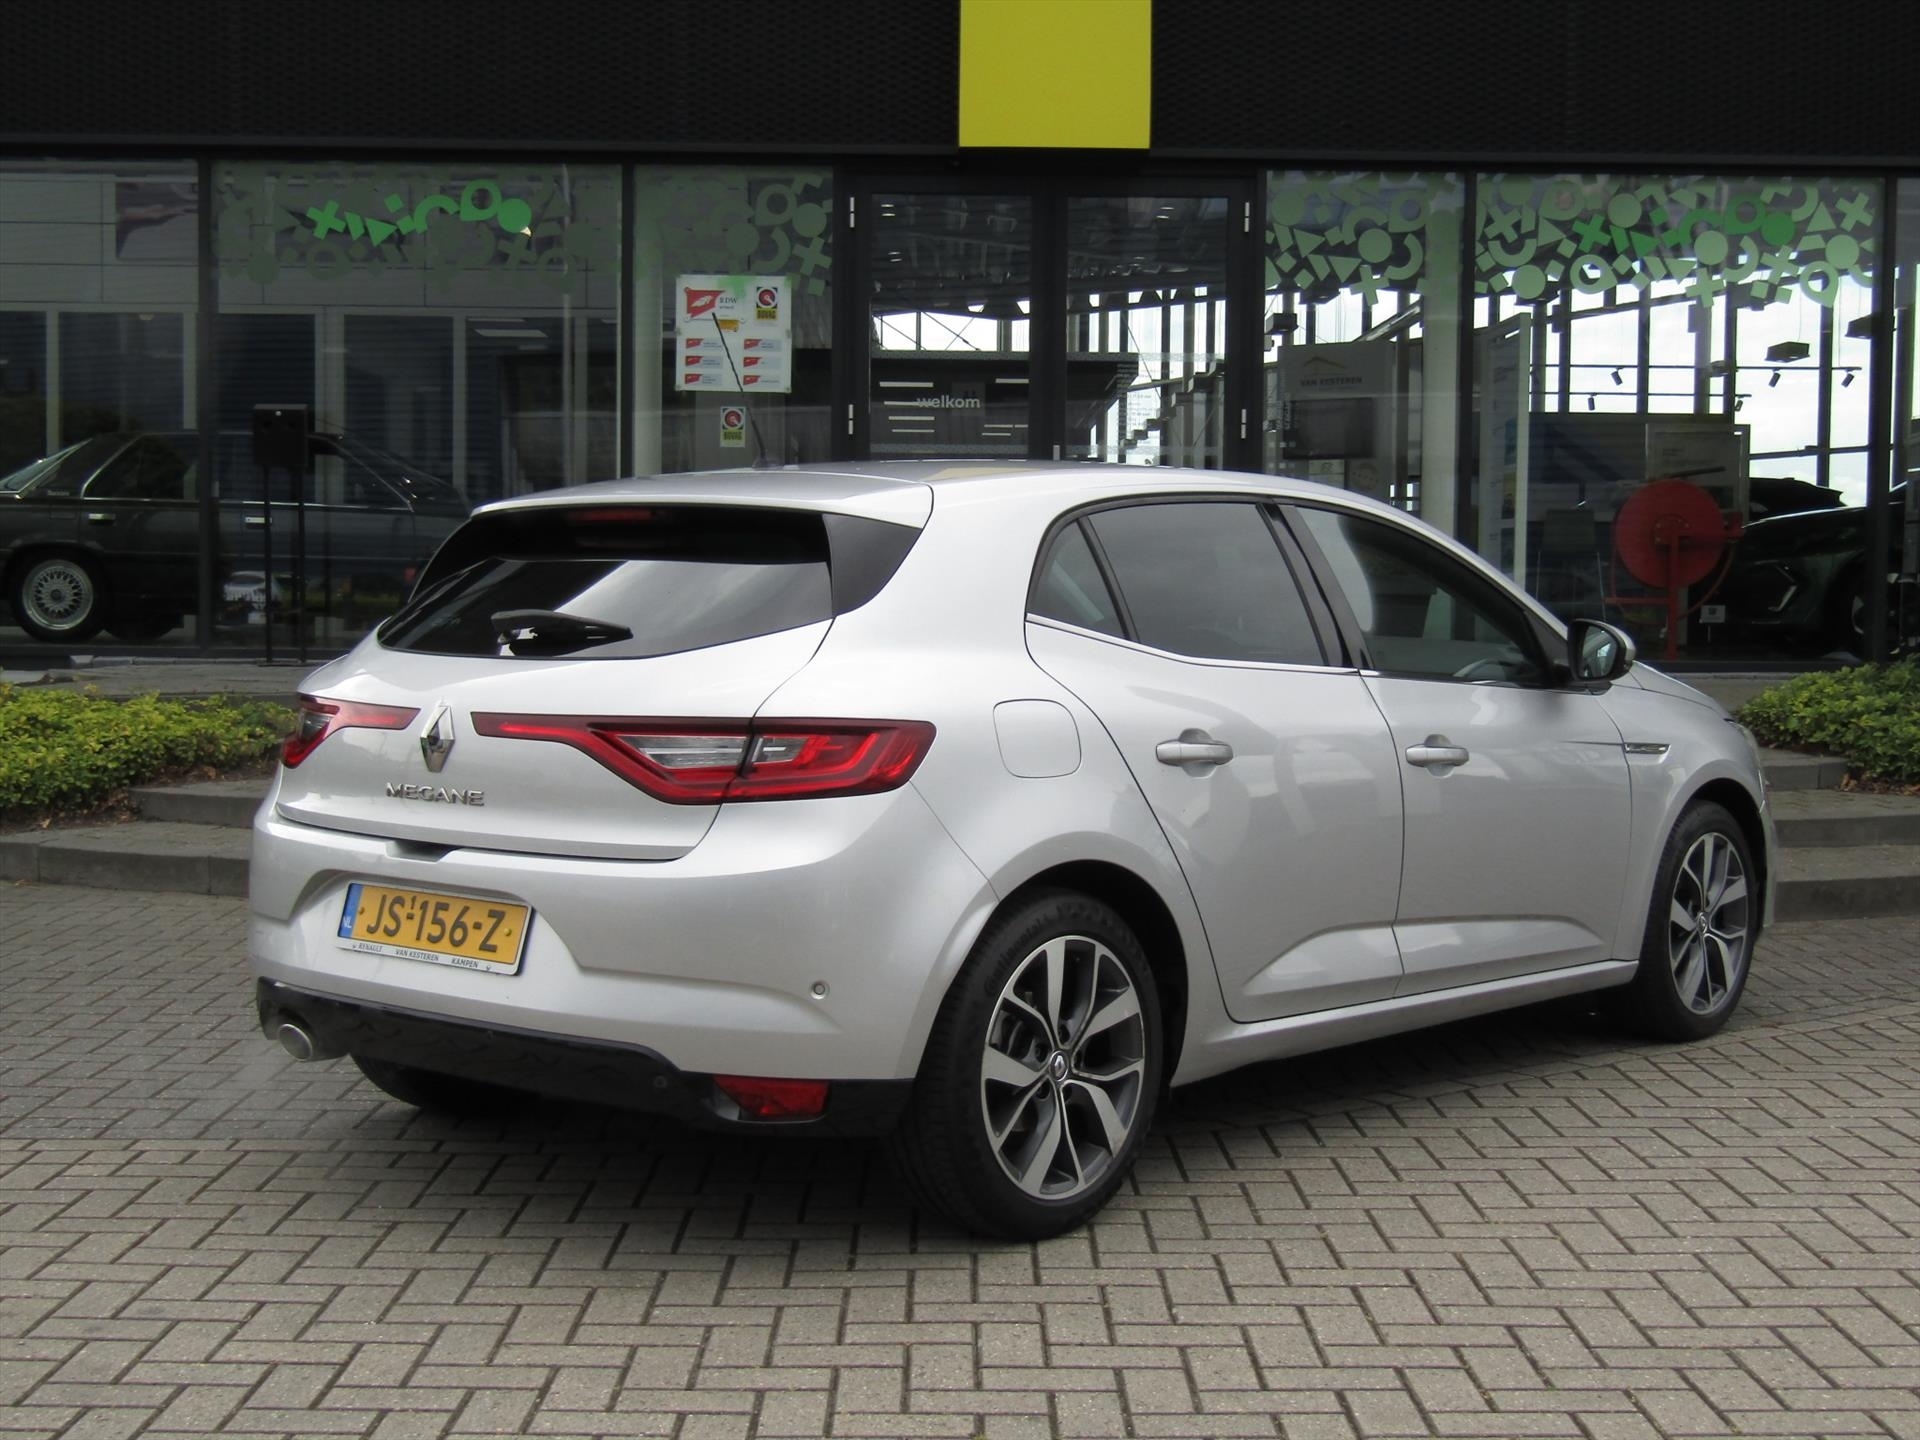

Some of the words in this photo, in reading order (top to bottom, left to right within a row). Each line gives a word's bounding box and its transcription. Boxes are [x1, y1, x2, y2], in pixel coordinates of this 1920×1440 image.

[916, 395, 981, 409] welkom
[385, 782, 485, 807] MEGANE
[358, 942, 383, 953] RENAULT
[395, 948, 409, 958] VAN
[408, 950, 439, 962] KESTEREN
[451, 957, 480, 969] KAMPEN
